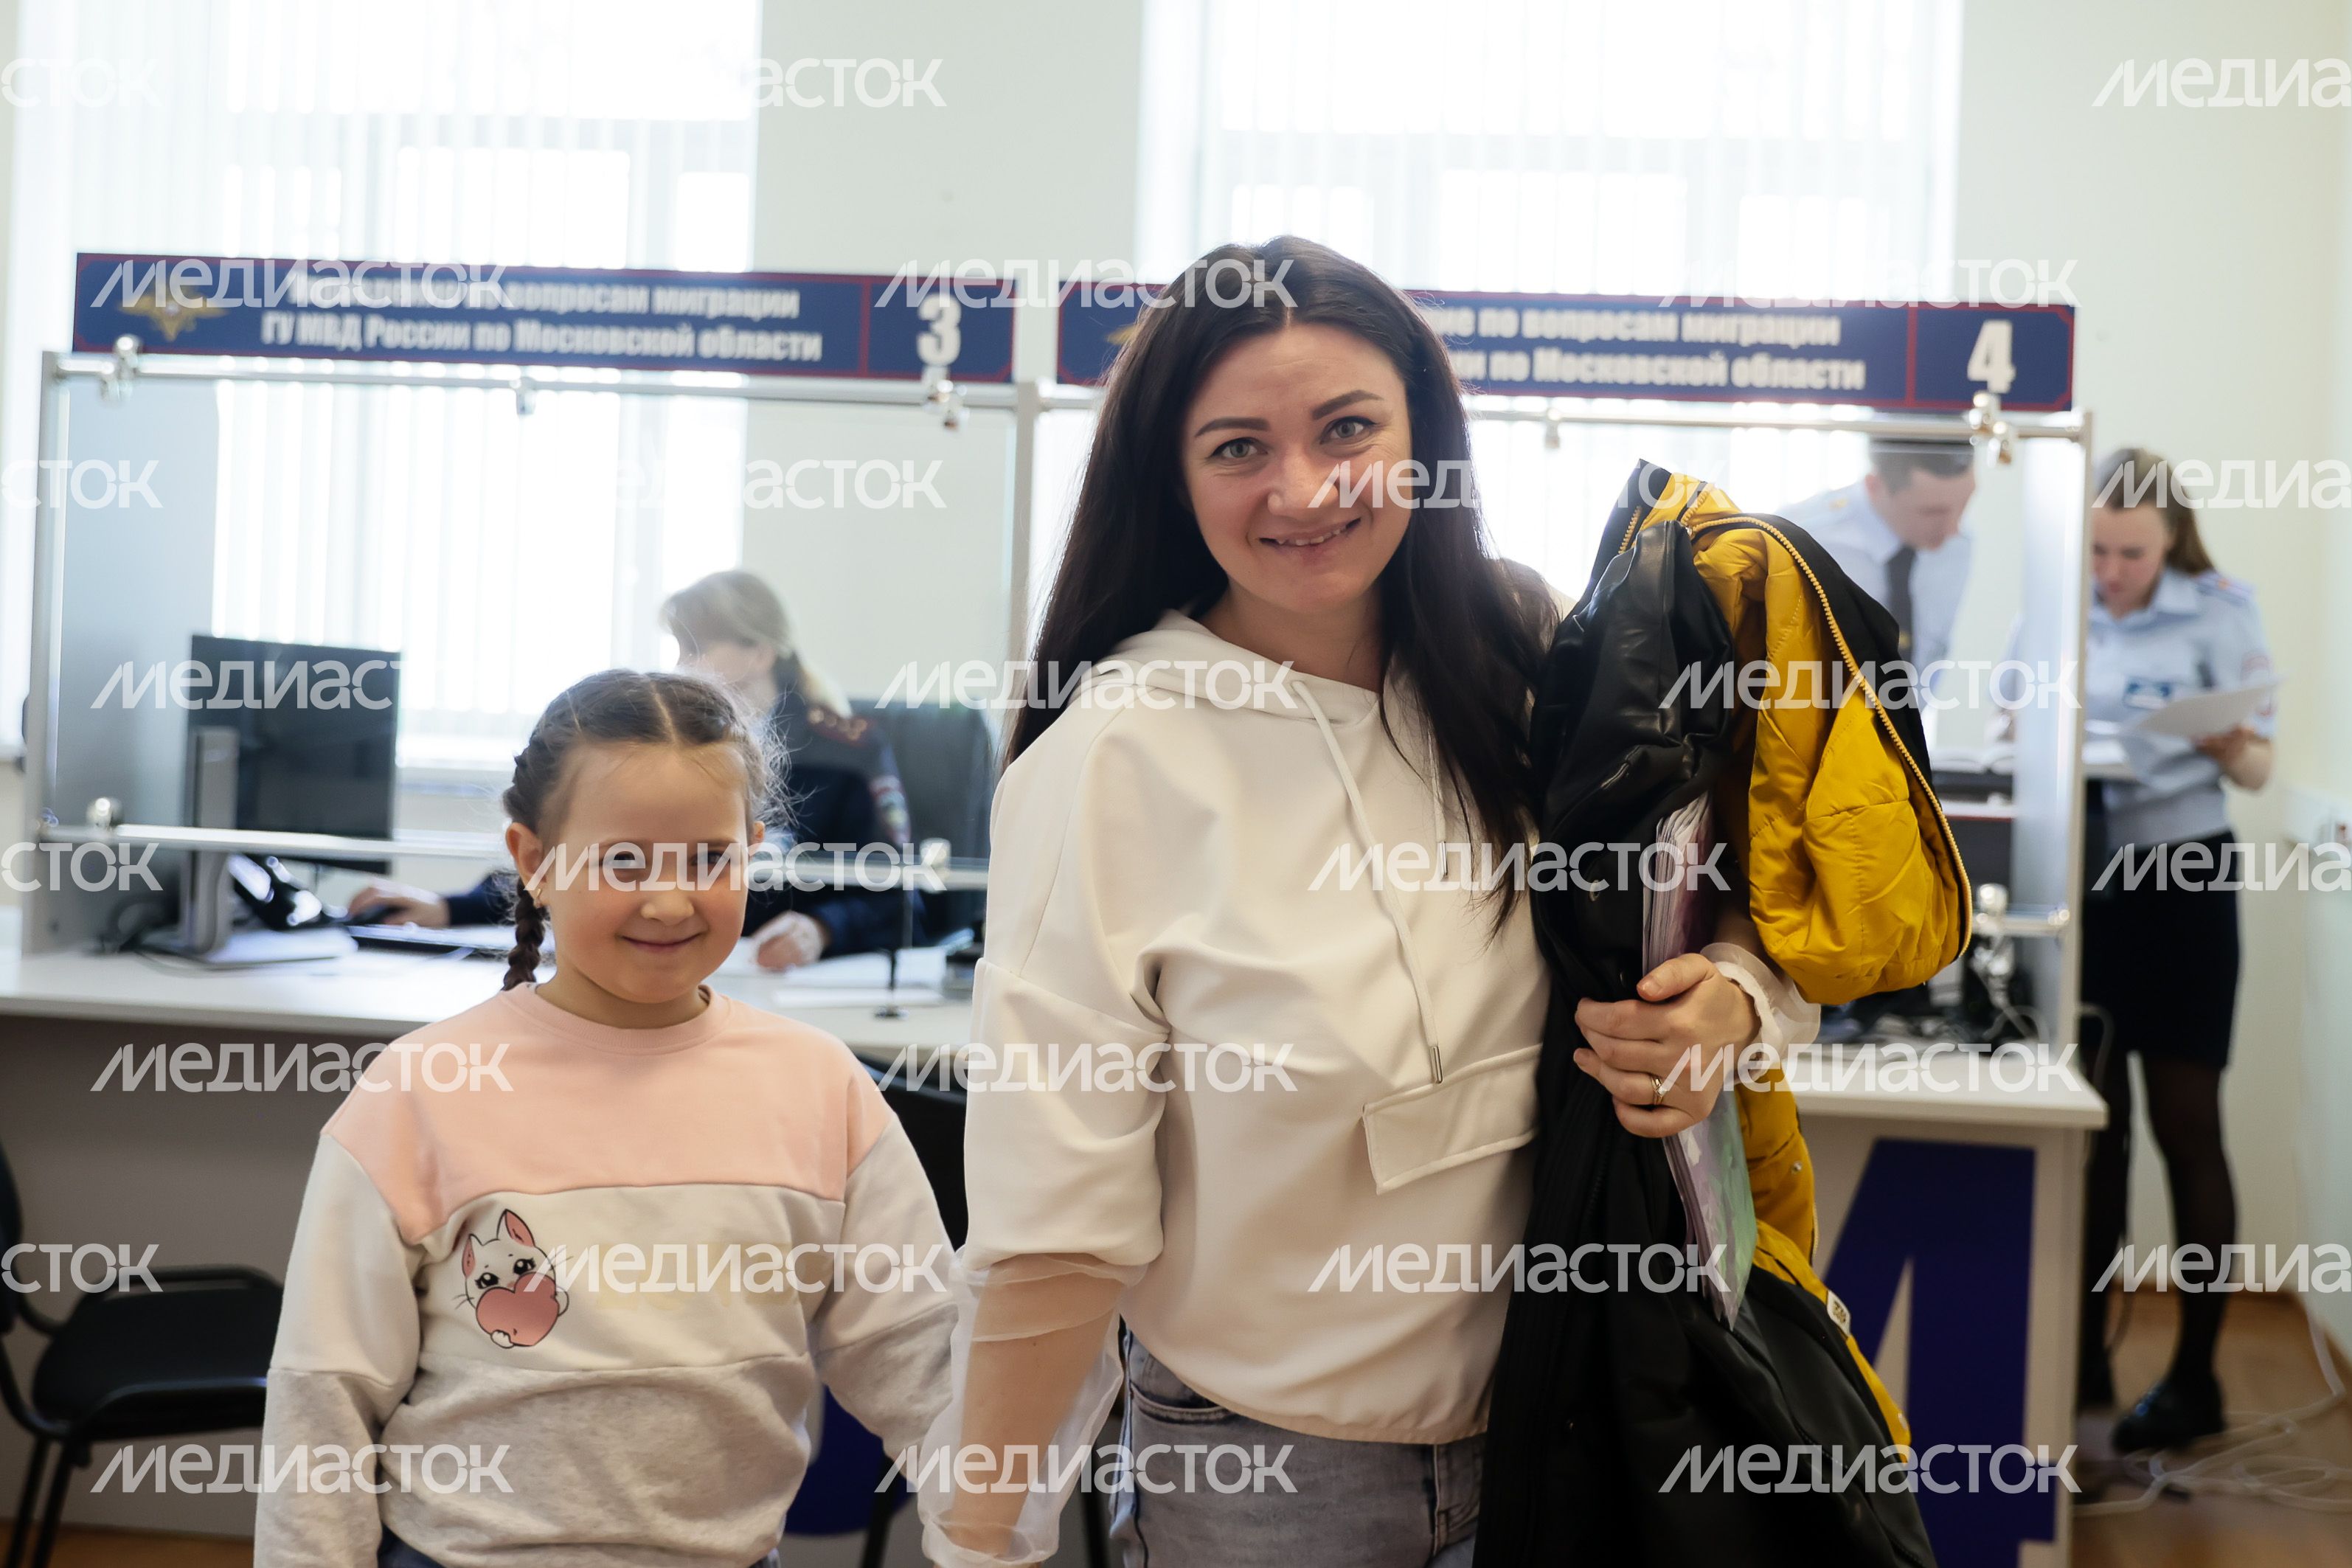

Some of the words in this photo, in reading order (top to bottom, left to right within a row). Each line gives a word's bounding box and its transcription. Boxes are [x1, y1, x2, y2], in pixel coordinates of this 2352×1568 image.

[652, 285, 800, 321] миграции
[261, 311, 294, 345] ГУ
[296, 312, 363, 352] МВД
[364, 313, 471, 350] России
[473, 321, 513, 352] по
[515, 317, 695, 358] Московской
[698, 325, 823, 361] области
[917, 293, 961, 366] 3
[1682, 313, 1842, 350] миграции
[1488, 350, 1530, 382] по
[1532, 346, 1728, 388] Московской
[1730, 350, 1866, 391] области
[1967, 319, 2016, 393] 4
